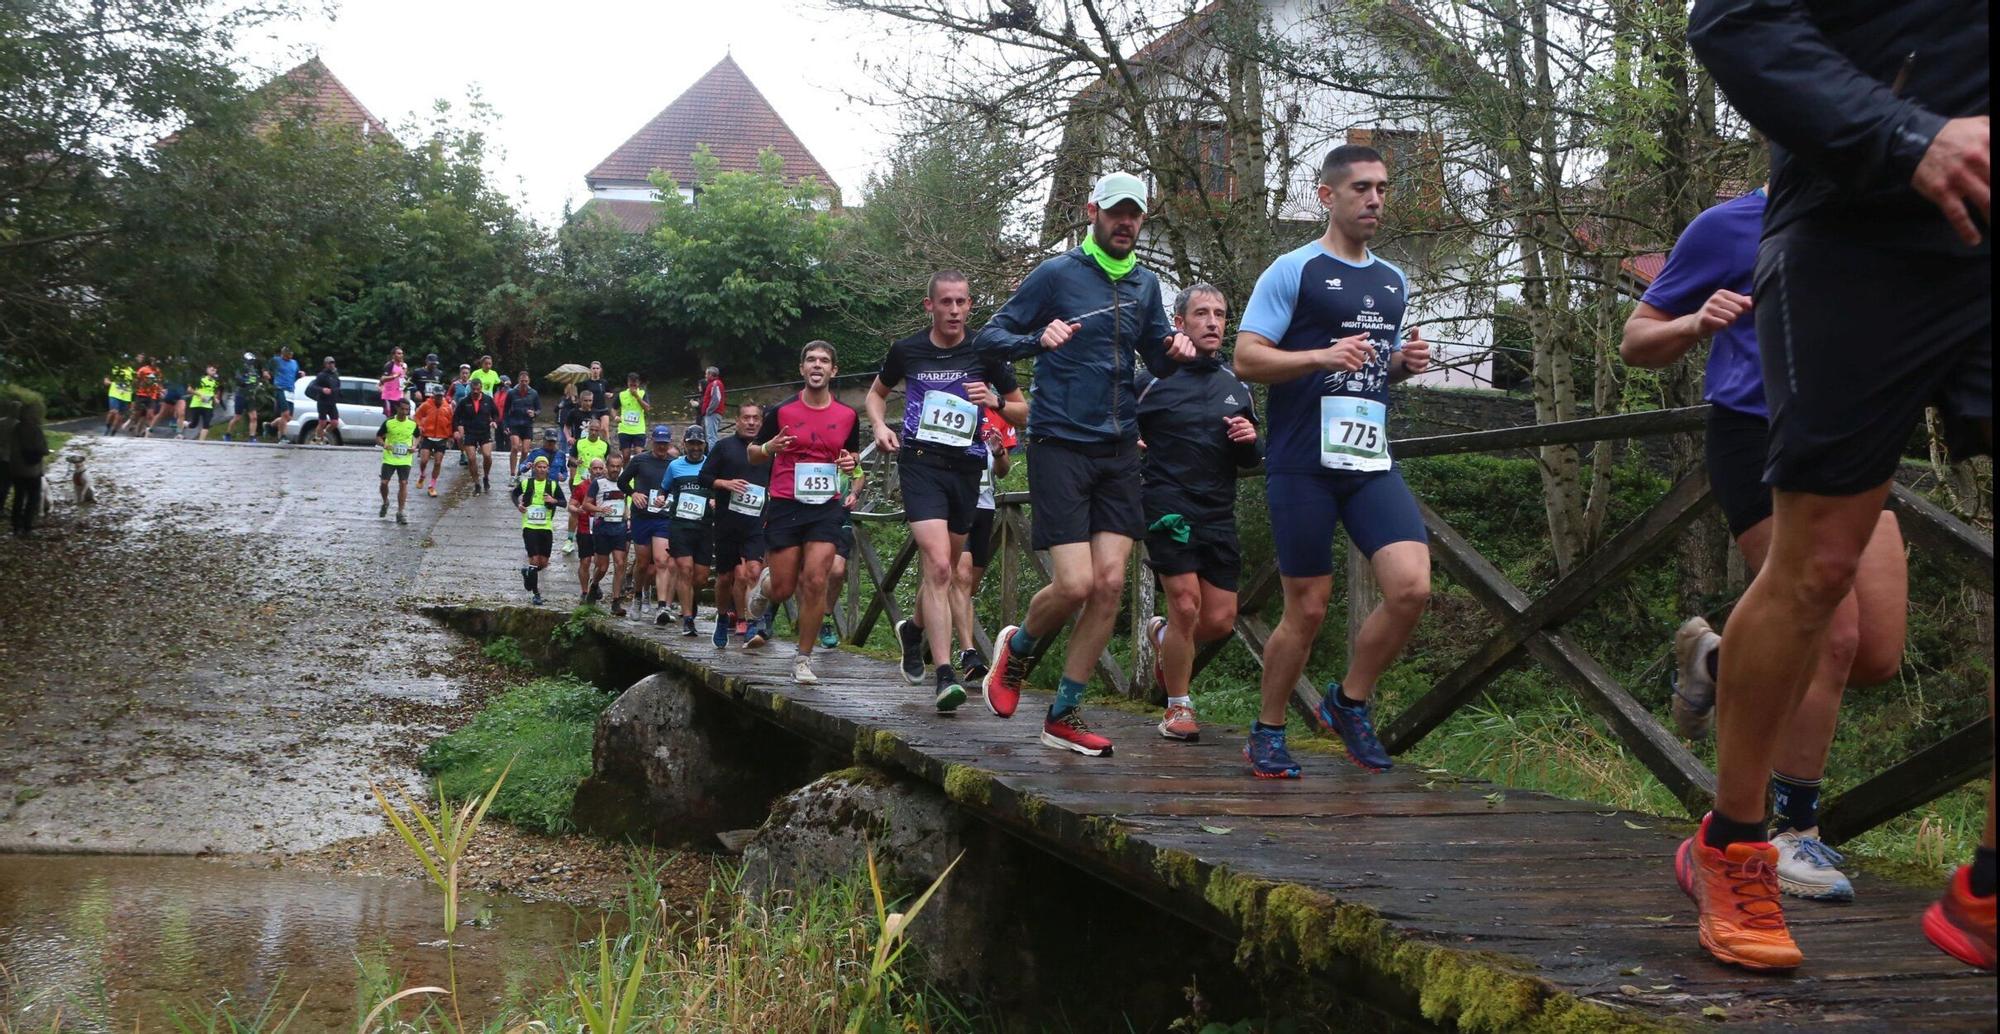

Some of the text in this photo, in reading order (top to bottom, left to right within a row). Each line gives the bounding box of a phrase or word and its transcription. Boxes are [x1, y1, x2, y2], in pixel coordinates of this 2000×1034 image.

[1357, 315, 1384, 323] BILBAO
[1341, 321, 1396, 331] NIGHT MARATHON
[933, 408, 965, 429] 149
[1340, 421, 1378, 449] 775
[804, 477, 829, 490] 453
[737, 493, 757, 505] 337
[683, 501, 699, 512] 902
